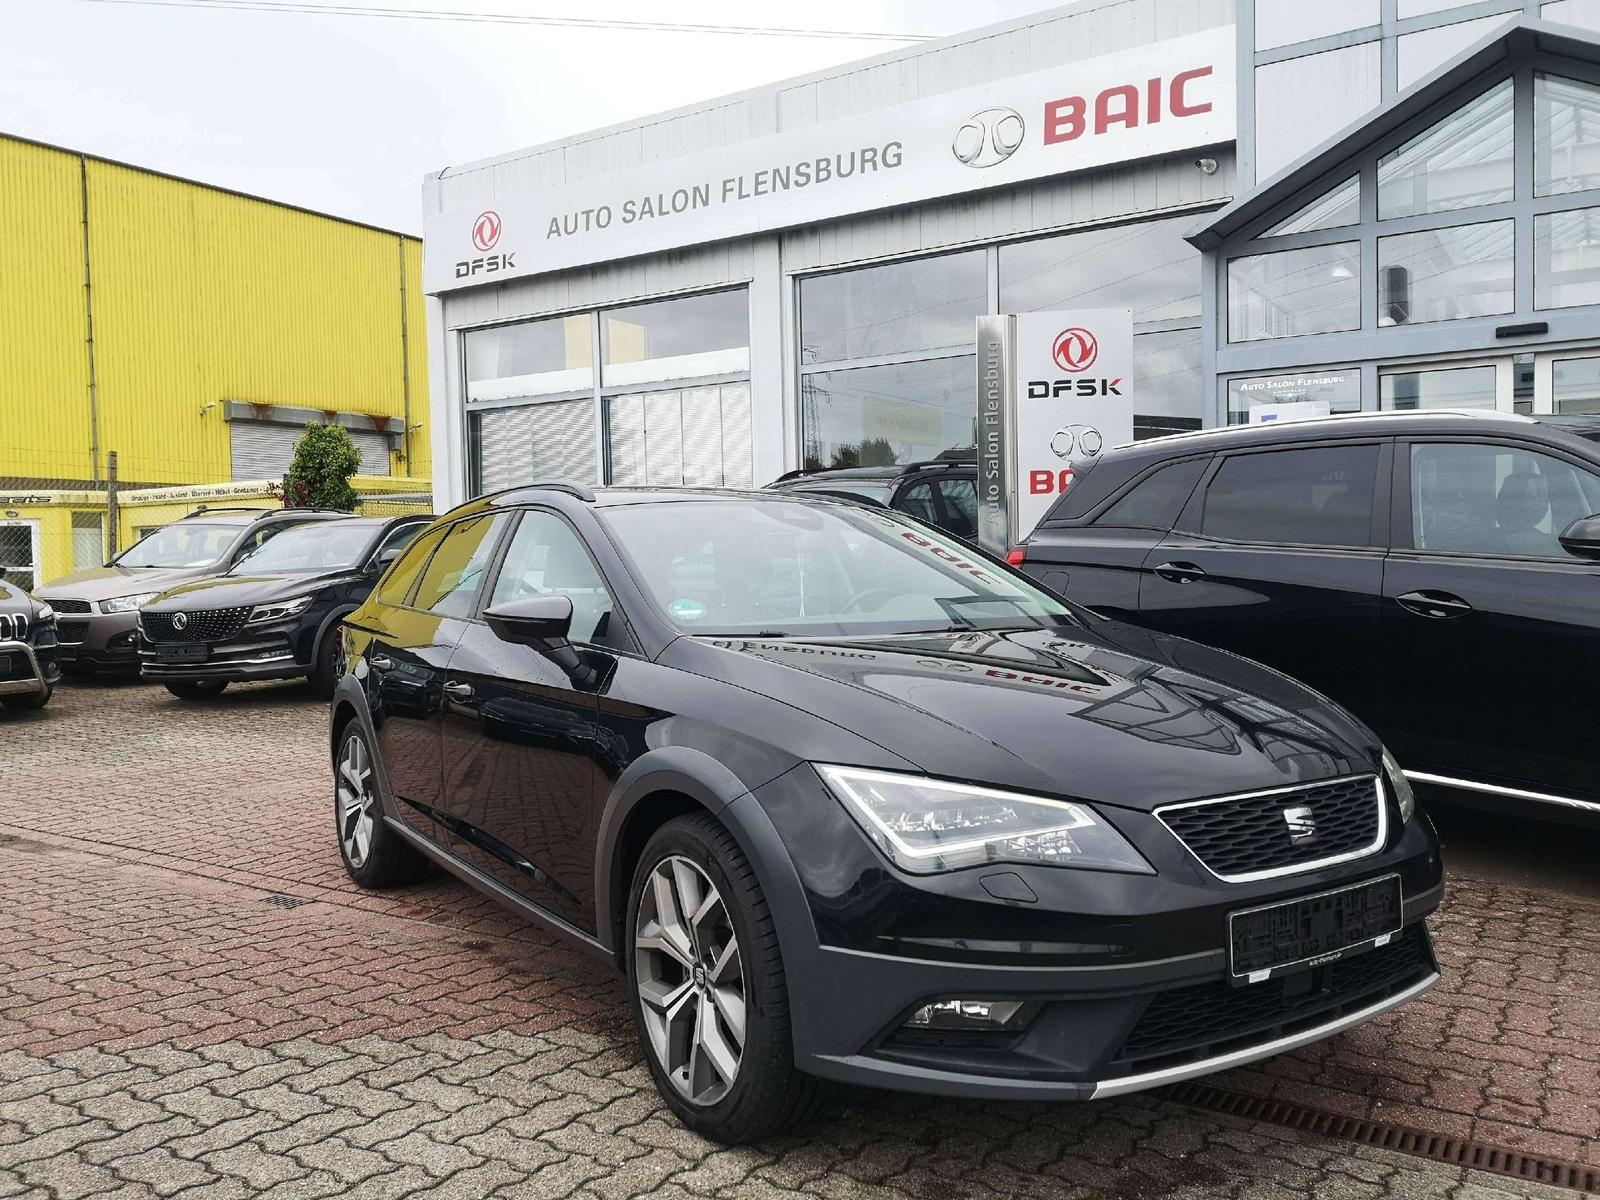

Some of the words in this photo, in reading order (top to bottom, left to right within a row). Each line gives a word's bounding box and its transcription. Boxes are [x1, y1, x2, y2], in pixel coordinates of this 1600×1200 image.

[1044, 65, 1213, 145] BAIC
[547, 206, 612, 239] AUTO
[622, 183, 710, 223] SALON
[722, 141, 903, 203] FLENSBURG
[456, 252, 516, 278] DFSK
[984, 342, 1000, 425] Flensburg
[1028, 379, 1122, 398] DFSK
[984, 433, 999, 478] Salon
